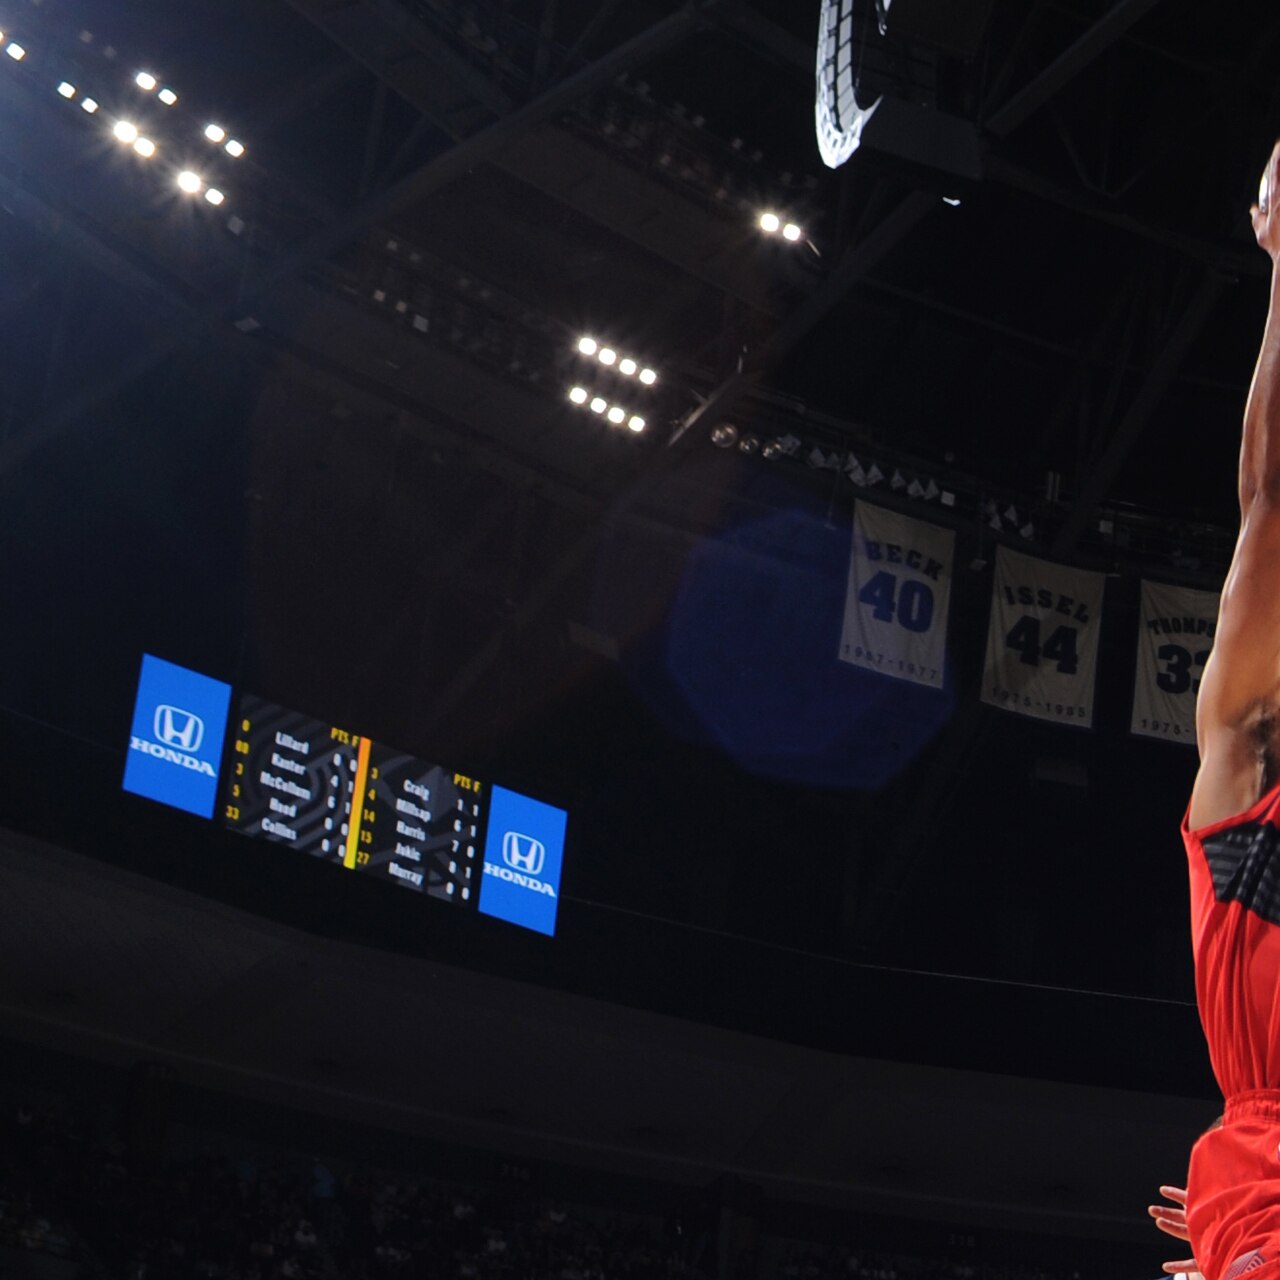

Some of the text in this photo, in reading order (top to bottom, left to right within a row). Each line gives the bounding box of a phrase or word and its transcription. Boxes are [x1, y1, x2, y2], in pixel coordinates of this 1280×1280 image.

[866, 541, 944, 581] BECK
[858, 570, 934, 633] 40
[1004, 585, 1089, 624] ISSEL
[1147, 618, 1216, 638] THOMPS
[1006, 615, 1079, 675] 44
[844, 644, 937, 680] 1967-1977
[992, 687, 1086, 718] 1975-1985
[275, 731, 309, 754] Lillard
[330, 727, 350, 745] PTS
[130, 736, 217, 778] HONDA
[260, 771, 311, 800] McCollum
[403, 779, 430, 802] Craig
[454, 773, 471, 790] PTS
[363, 809, 426, 842] 14 Harris
[484, 861, 557, 898] HONDA
